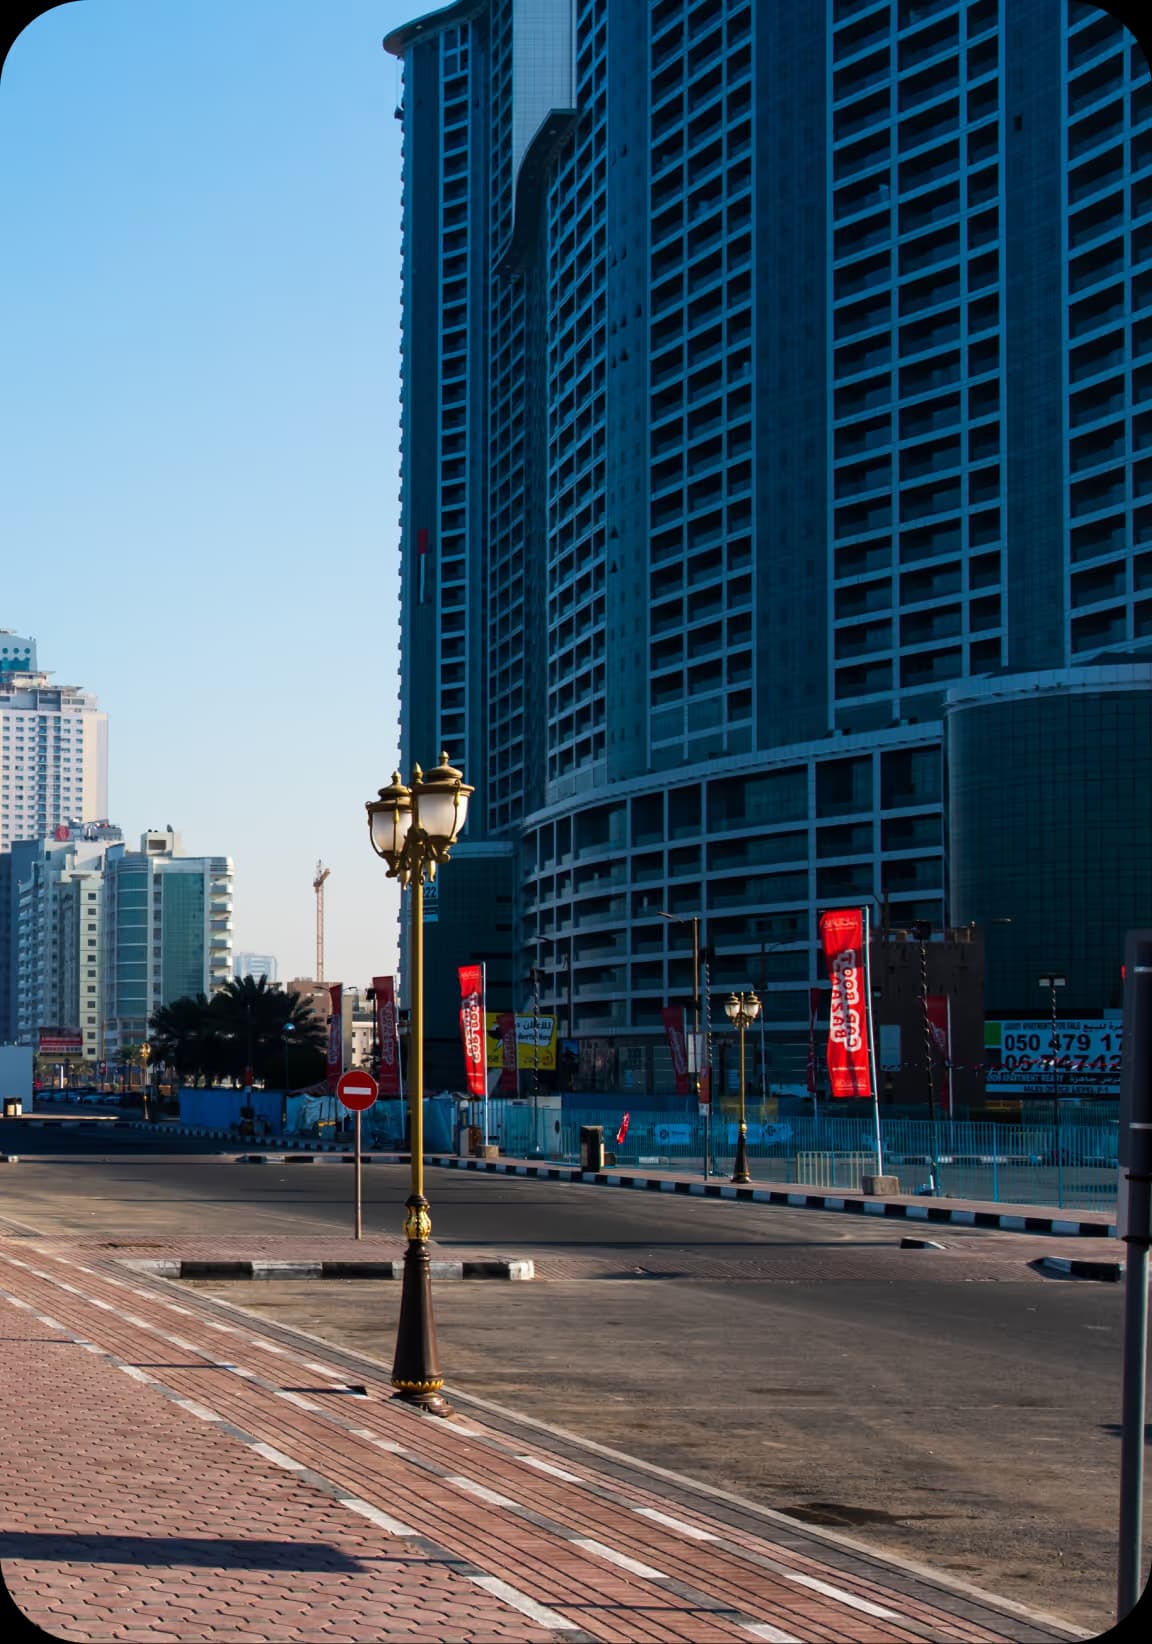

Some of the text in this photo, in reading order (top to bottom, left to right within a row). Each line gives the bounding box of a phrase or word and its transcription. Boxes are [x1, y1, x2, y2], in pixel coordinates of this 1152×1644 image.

[424, 886, 437, 898] 22
[1005, 1034, 1040, 1051] 050
[1048, 1034, 1091, 1051] 479
[1005, 1054, 1033, 1071] 06
